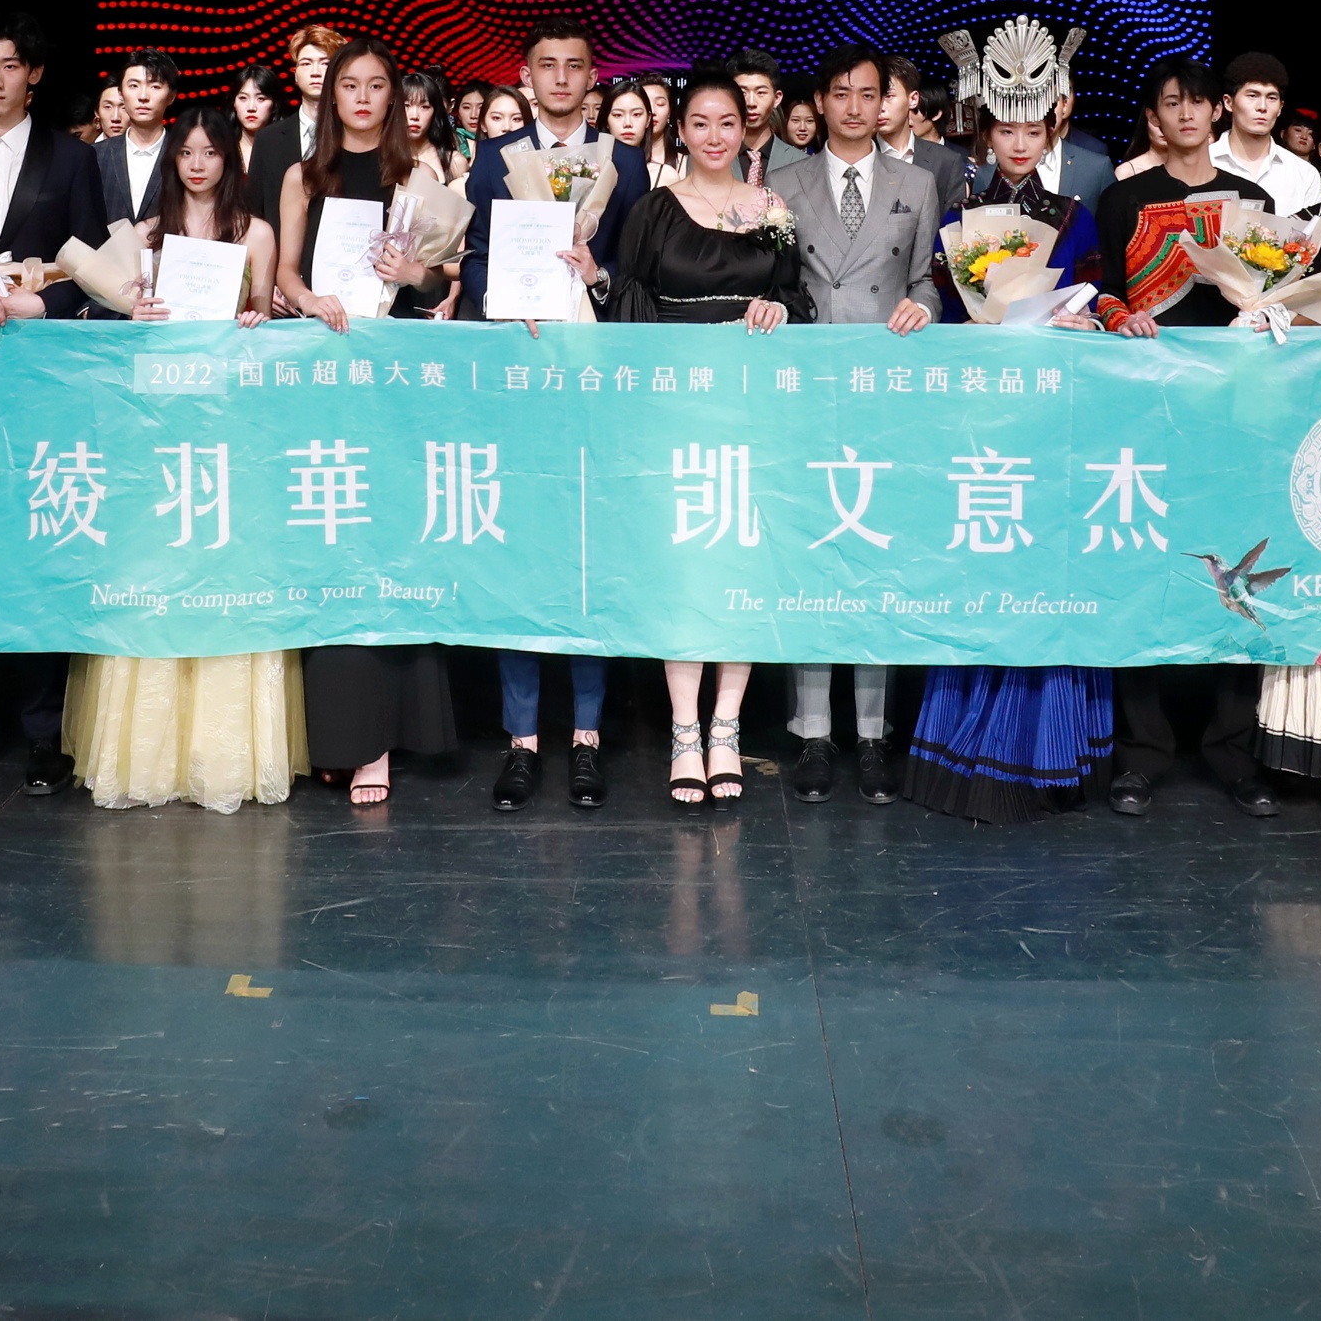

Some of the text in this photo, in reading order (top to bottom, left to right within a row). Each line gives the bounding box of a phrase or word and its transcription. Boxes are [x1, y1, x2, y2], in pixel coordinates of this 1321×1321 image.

[150, 359, 1063, 394] 2022 国际超模大赛 官方合作品牌 唯一指定西装品牌
[671, 443, 1169, 553] 凯文意杰
[90, 584, 170, 616] Nothing
[181, 589, 275, 615] compares
[288, 586, 308, 601] to
[319, 583, 366, 607] your
[724, 589, 1099, 615] The relentless Pursuit of Perfection
